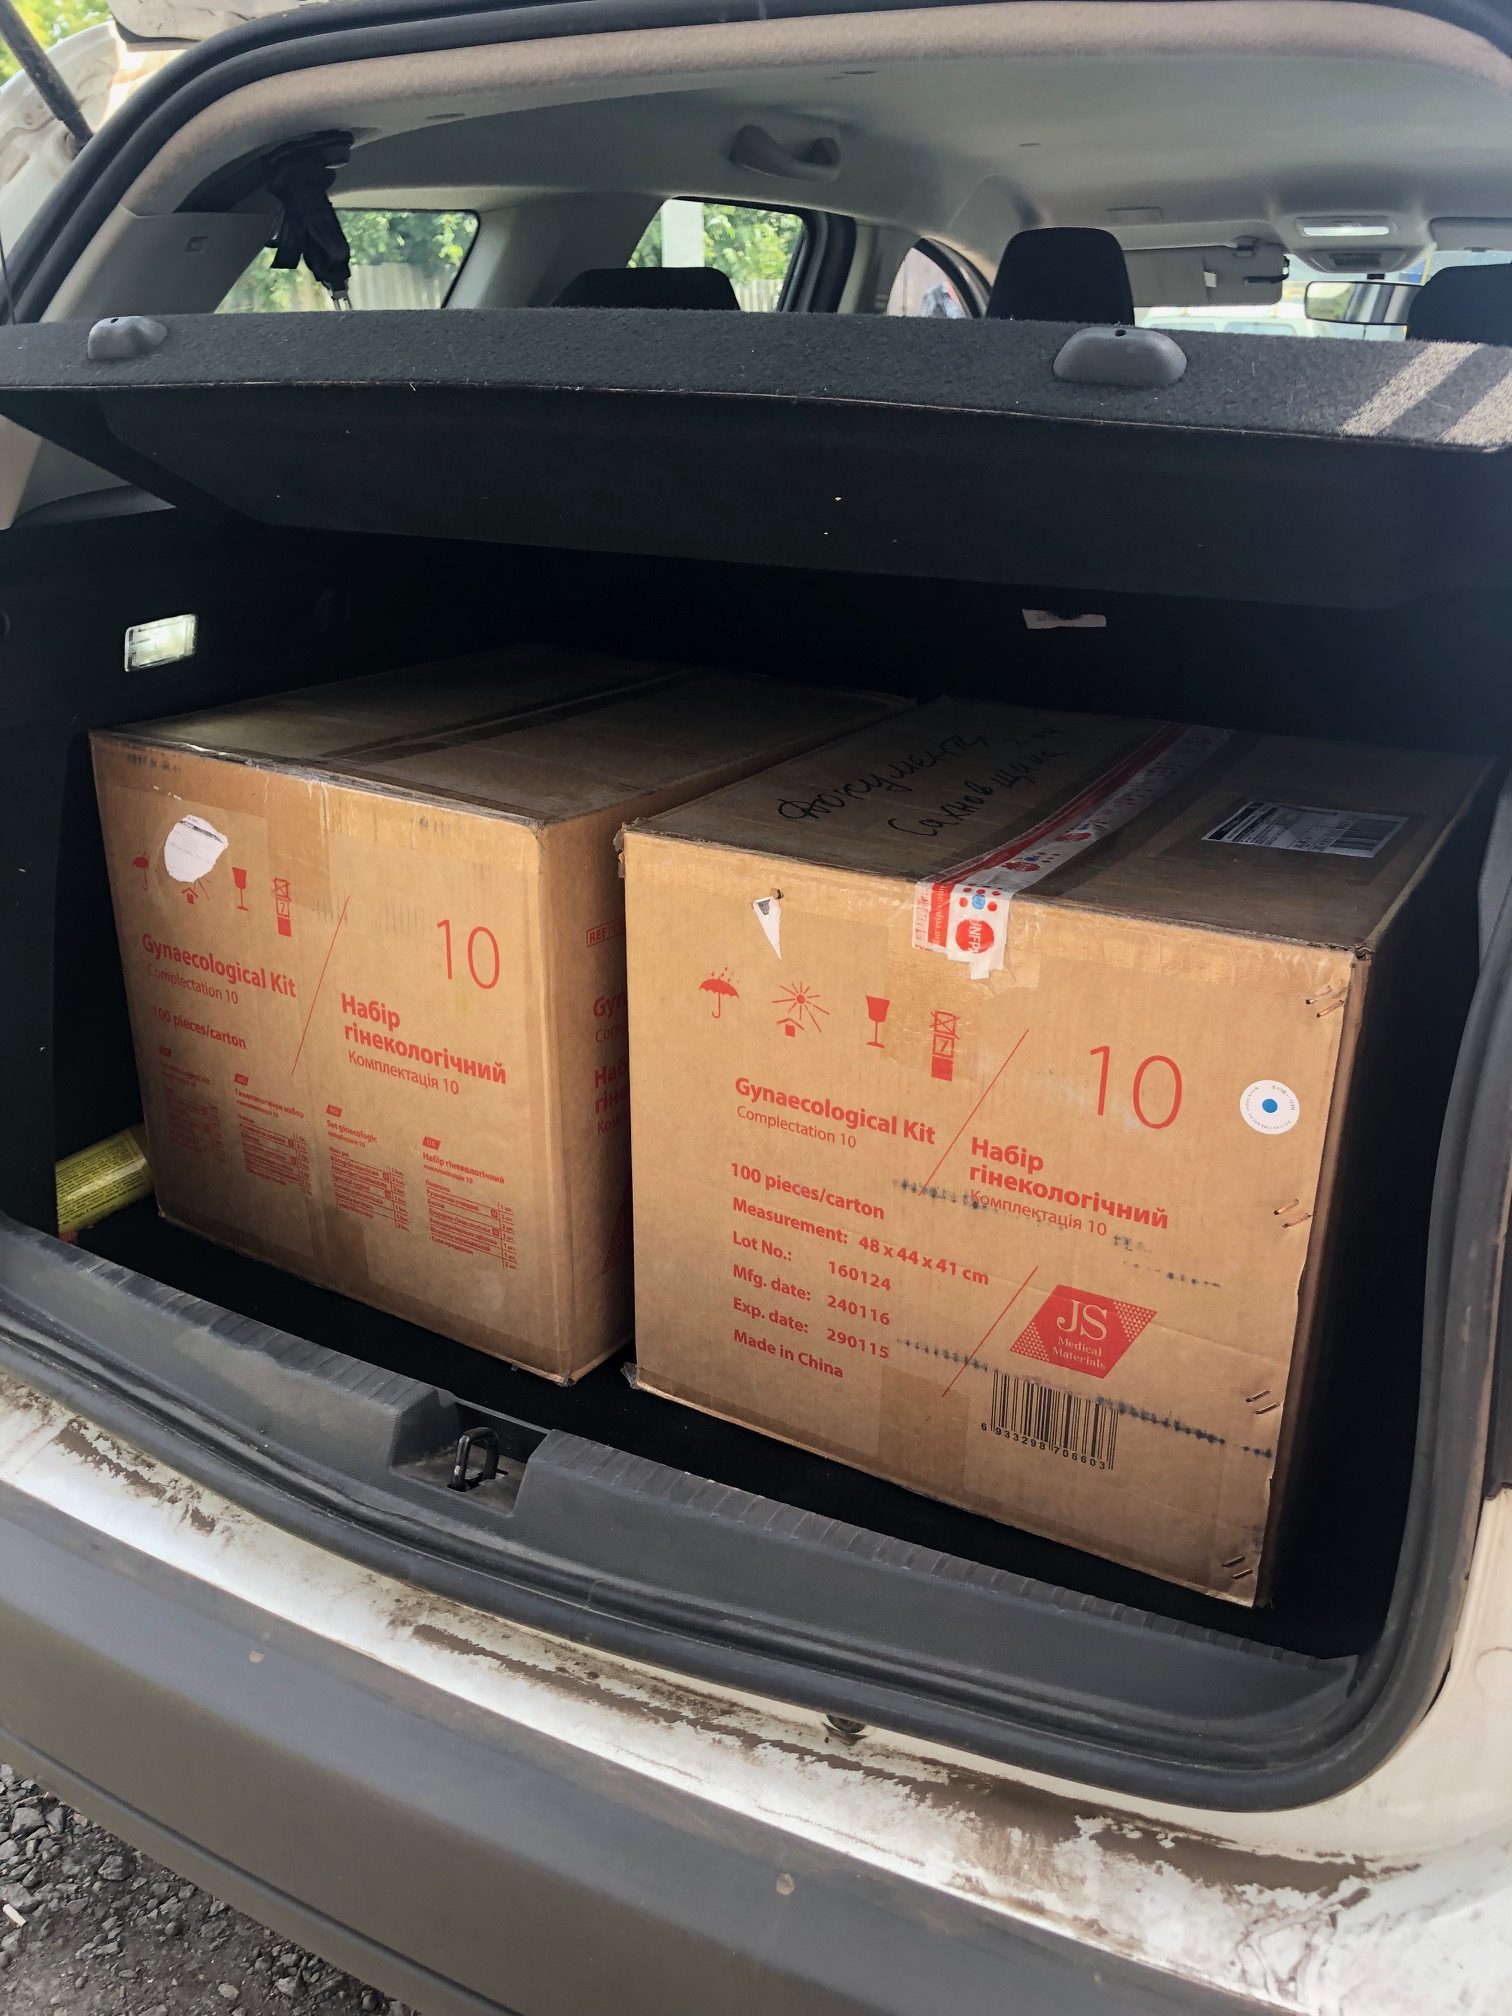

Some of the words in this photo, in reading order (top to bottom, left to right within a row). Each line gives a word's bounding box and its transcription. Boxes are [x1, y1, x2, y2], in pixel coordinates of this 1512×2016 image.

[437, 919, 500, 989] 10
[589, 926, 608, 943] REF
[142, 933, 266, 988] Gynaecological
[270, 972, 297, 998] Kit
[147, 964, 223, 999] Complectation
[225, 989, 239, 1004] 10
[173, 1015, 246, 1049] pieces/carton
[341, 993, 400, 1031] Набір
[344, 1023, 506, 1084] гінекологічний
[348, 1049, 439, 1089] Комплектація
[443, 1079, 459, 1096] 10
[735, 1077, 897, 1135] Gynaecological
[903, 1119, 935, 1144] Kit
[1089, 1045, 1183, 1129] 10
[737, 1105, 835, 1143] Complectation
[840, 1133, 856, 1148] 10
[971, 1136, 1044, 1174] Набір
[731, 1163, 761, 1184] 100
[765, 1174, 885, 1220] pieces/carton
[969, 1165, 1168, 1229] гінекологічний
[970, 1189, 1082, 1230] Комплектація
[1087, 1219, 1107, 1236] 10
[733, 1197, 848, 1244] Measurement:
[858, 1236, 880, 1253] 48
[883, 1245, 893, 1257] x
[896, 1247, 919, 1264] 44
[922, 1257, 933, 1269] x
[935, 1258, 958, 1276] 41
[962, 1268, 989, 1285] cm
[733, 1231, 757, 1251] Lot
[761, 1239, 792, 1261] No.:
[828, 1261, 891, 1291] 160124
[733, 1264, 767, 1288] Mfg.
[770, 1277, 811, 1301] date:
[827, 1295, 890, 1325] 240116
[733, 1296, 765, 1319] Exp.
[768, 1309, 809, 1333] date:
[826, 1328, 889, 1359] 290115
[1056, 1299, 1107, 1340] JS
[733, 1329, 776, 1354] Made
[779, 1345, 794, 1361] in
[797, 1351, 844, 1378] China
[1052, 1346, 1106, 1370] Materials
[1056, 1335, 1102, 1357] Medical
